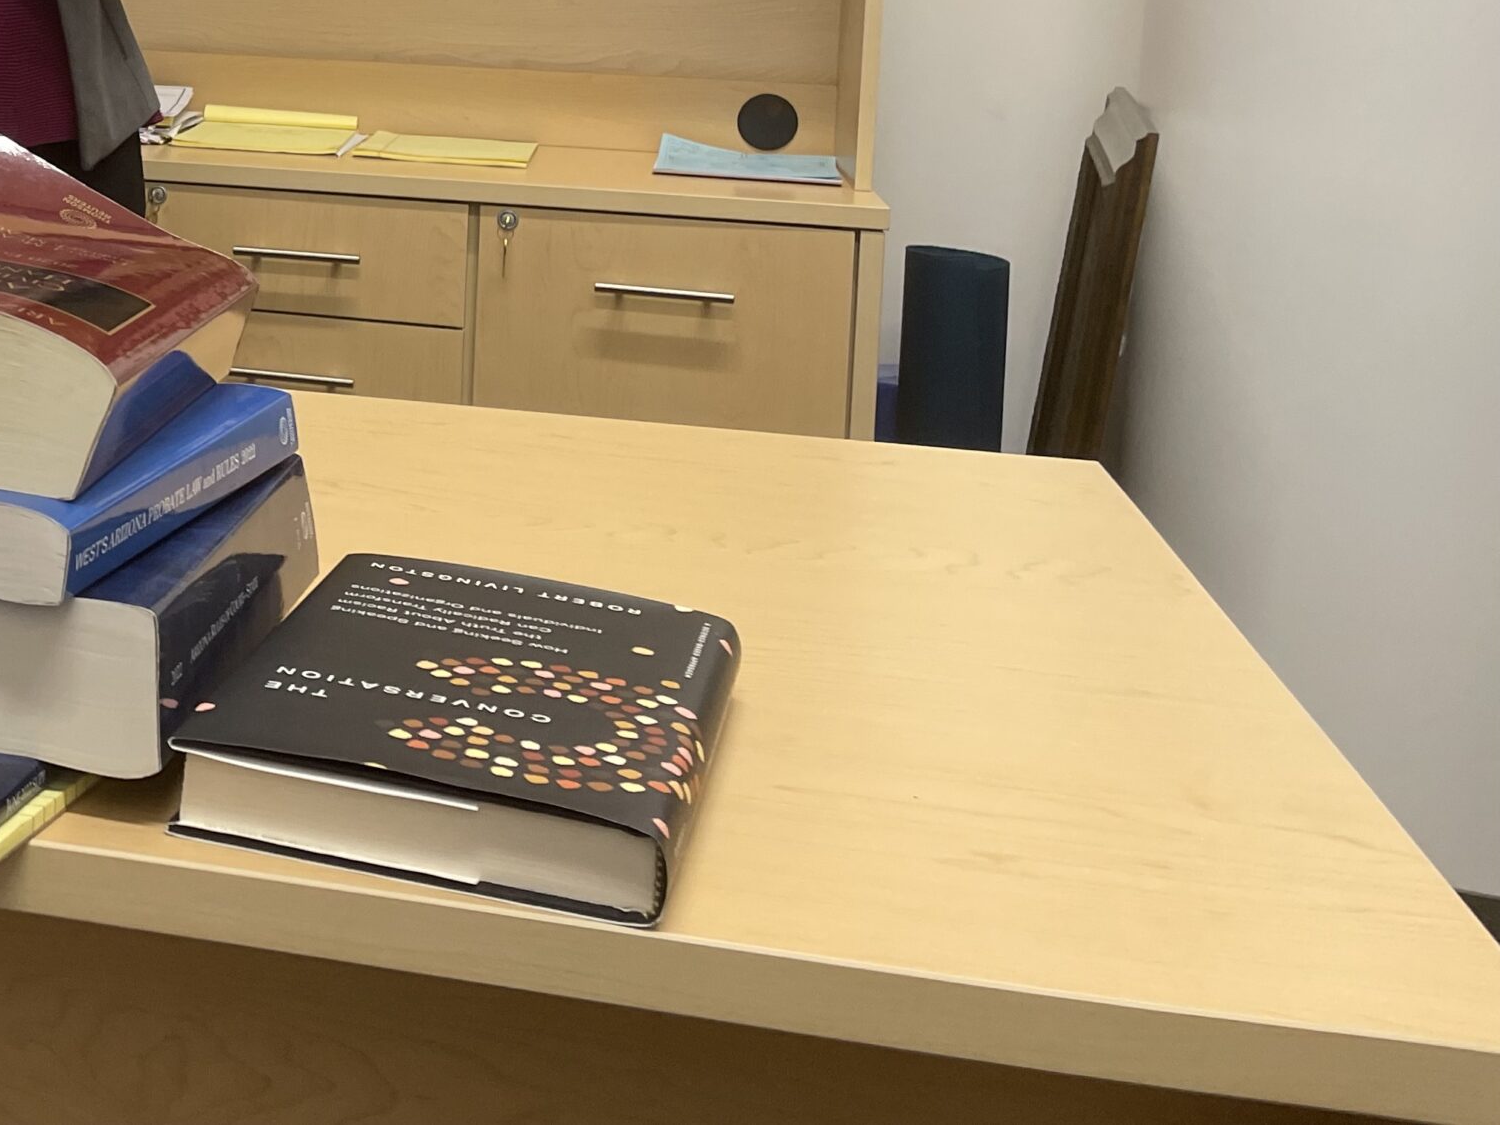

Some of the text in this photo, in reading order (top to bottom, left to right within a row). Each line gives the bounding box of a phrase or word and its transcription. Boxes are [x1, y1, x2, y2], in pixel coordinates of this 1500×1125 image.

[108, 511, 148, 548] ARIZONA
[148, 487, 185, 525] PROBATE
[185, 478, 203, 504] LAW
[203, 467, 217, 490] and
[216, 451, 240, 484] RULES
[344, 591, 552, 633] Can Radically Transform
[350, 584, 603, 634] Individuals and Organizations
[370, 561, 642, 615] ROBERT LIVINGSTON
[330, 605, 569, 654] How Seeking and Speaking
[338, 598, 542, 640] the Truth About Racism
[264, 680, 328, 699] THE
[276, 666, 552, 724] CONVERSATION
